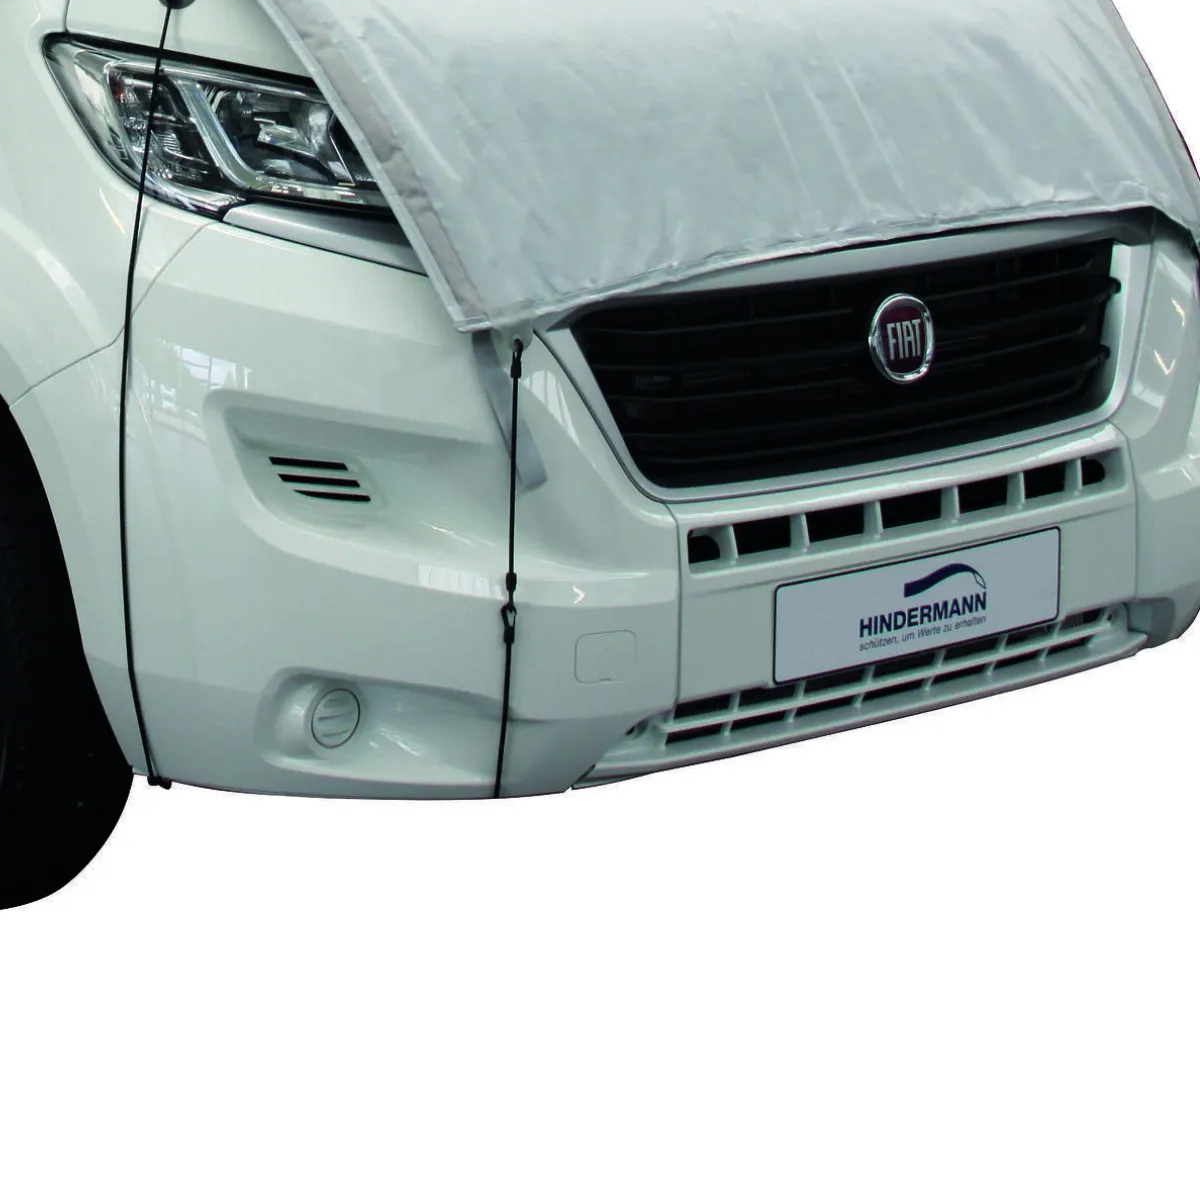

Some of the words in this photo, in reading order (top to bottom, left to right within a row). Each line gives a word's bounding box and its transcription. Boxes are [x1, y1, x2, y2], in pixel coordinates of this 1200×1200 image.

[886, 319, 921, 361] FIAT
[859, 592, 987, 638] HINDERMANN
[859, 634, 900, 651] schützen,
[902, 631, 915, 643] um
[917, 625, 941, 639] Werte
[943, 623, 952, 632] zu
[954, 615, 987, 631] erhalten
